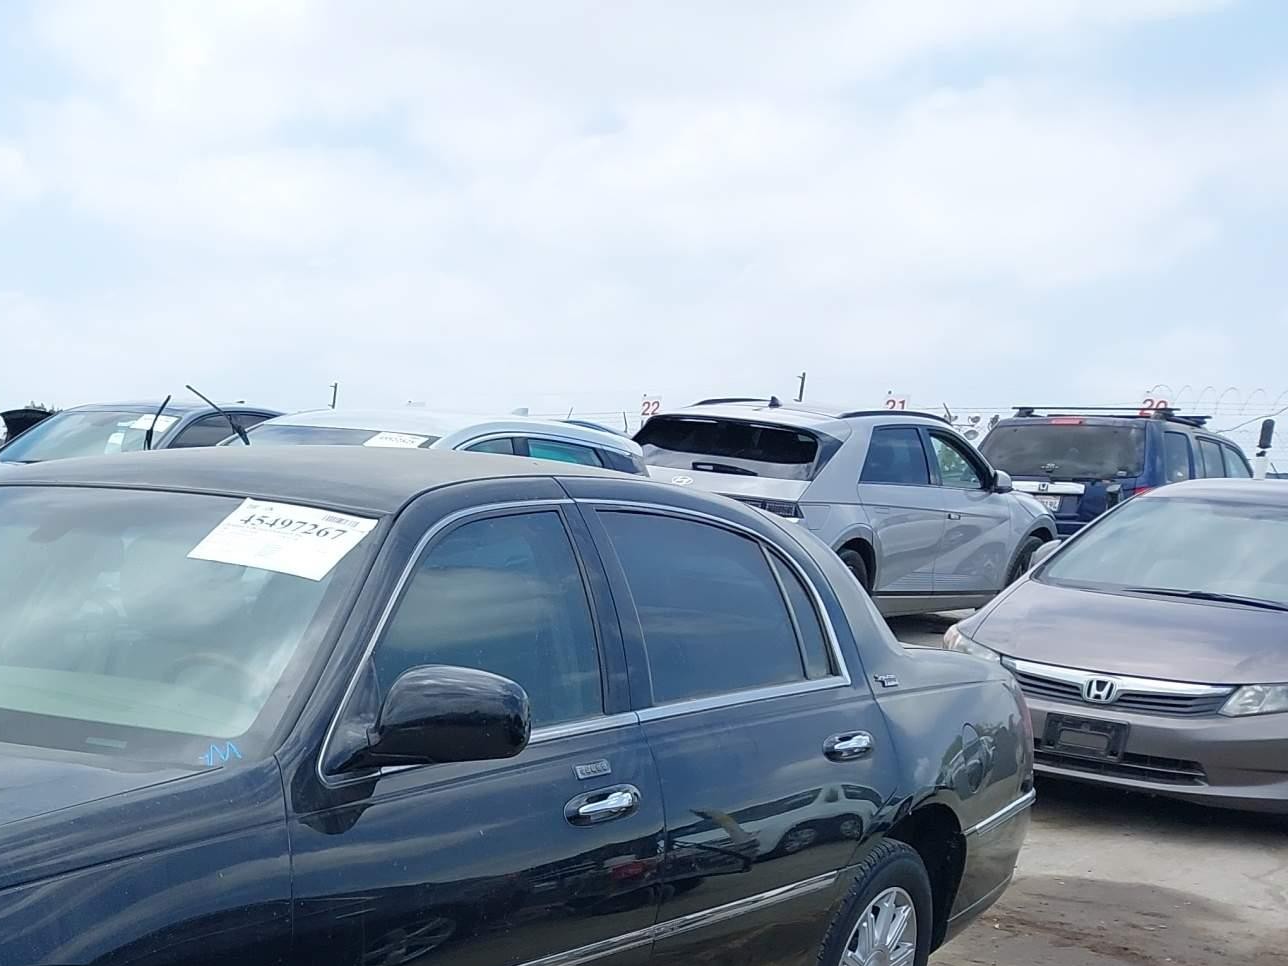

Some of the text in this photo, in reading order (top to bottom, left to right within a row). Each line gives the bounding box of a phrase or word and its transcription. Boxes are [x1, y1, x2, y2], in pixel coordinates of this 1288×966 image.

[641, 401, 660, 416] 22
[885, 399, 906, 411] 21
[240, 514, 348, 540] 45497267
